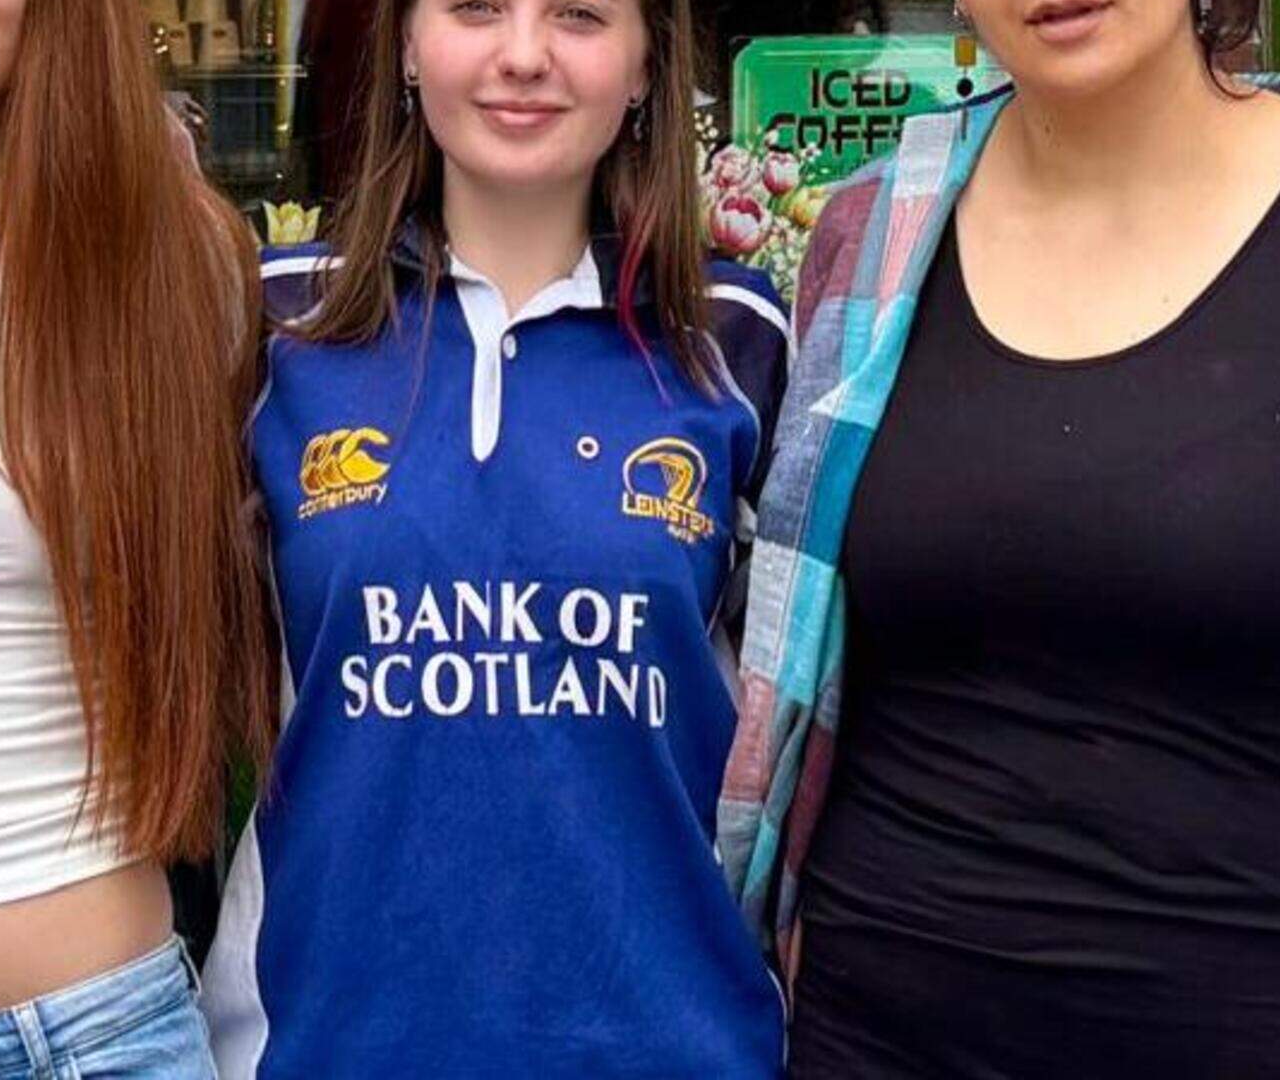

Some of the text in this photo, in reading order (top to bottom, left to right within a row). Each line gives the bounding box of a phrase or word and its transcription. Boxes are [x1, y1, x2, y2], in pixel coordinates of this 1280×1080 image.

[810, 68, 911, 110] ICED
[764, 111, 907, 156] COFF
[362, 579, 650, 653] BANK OF
[339, 651, 668, 730] SCOTLAND
